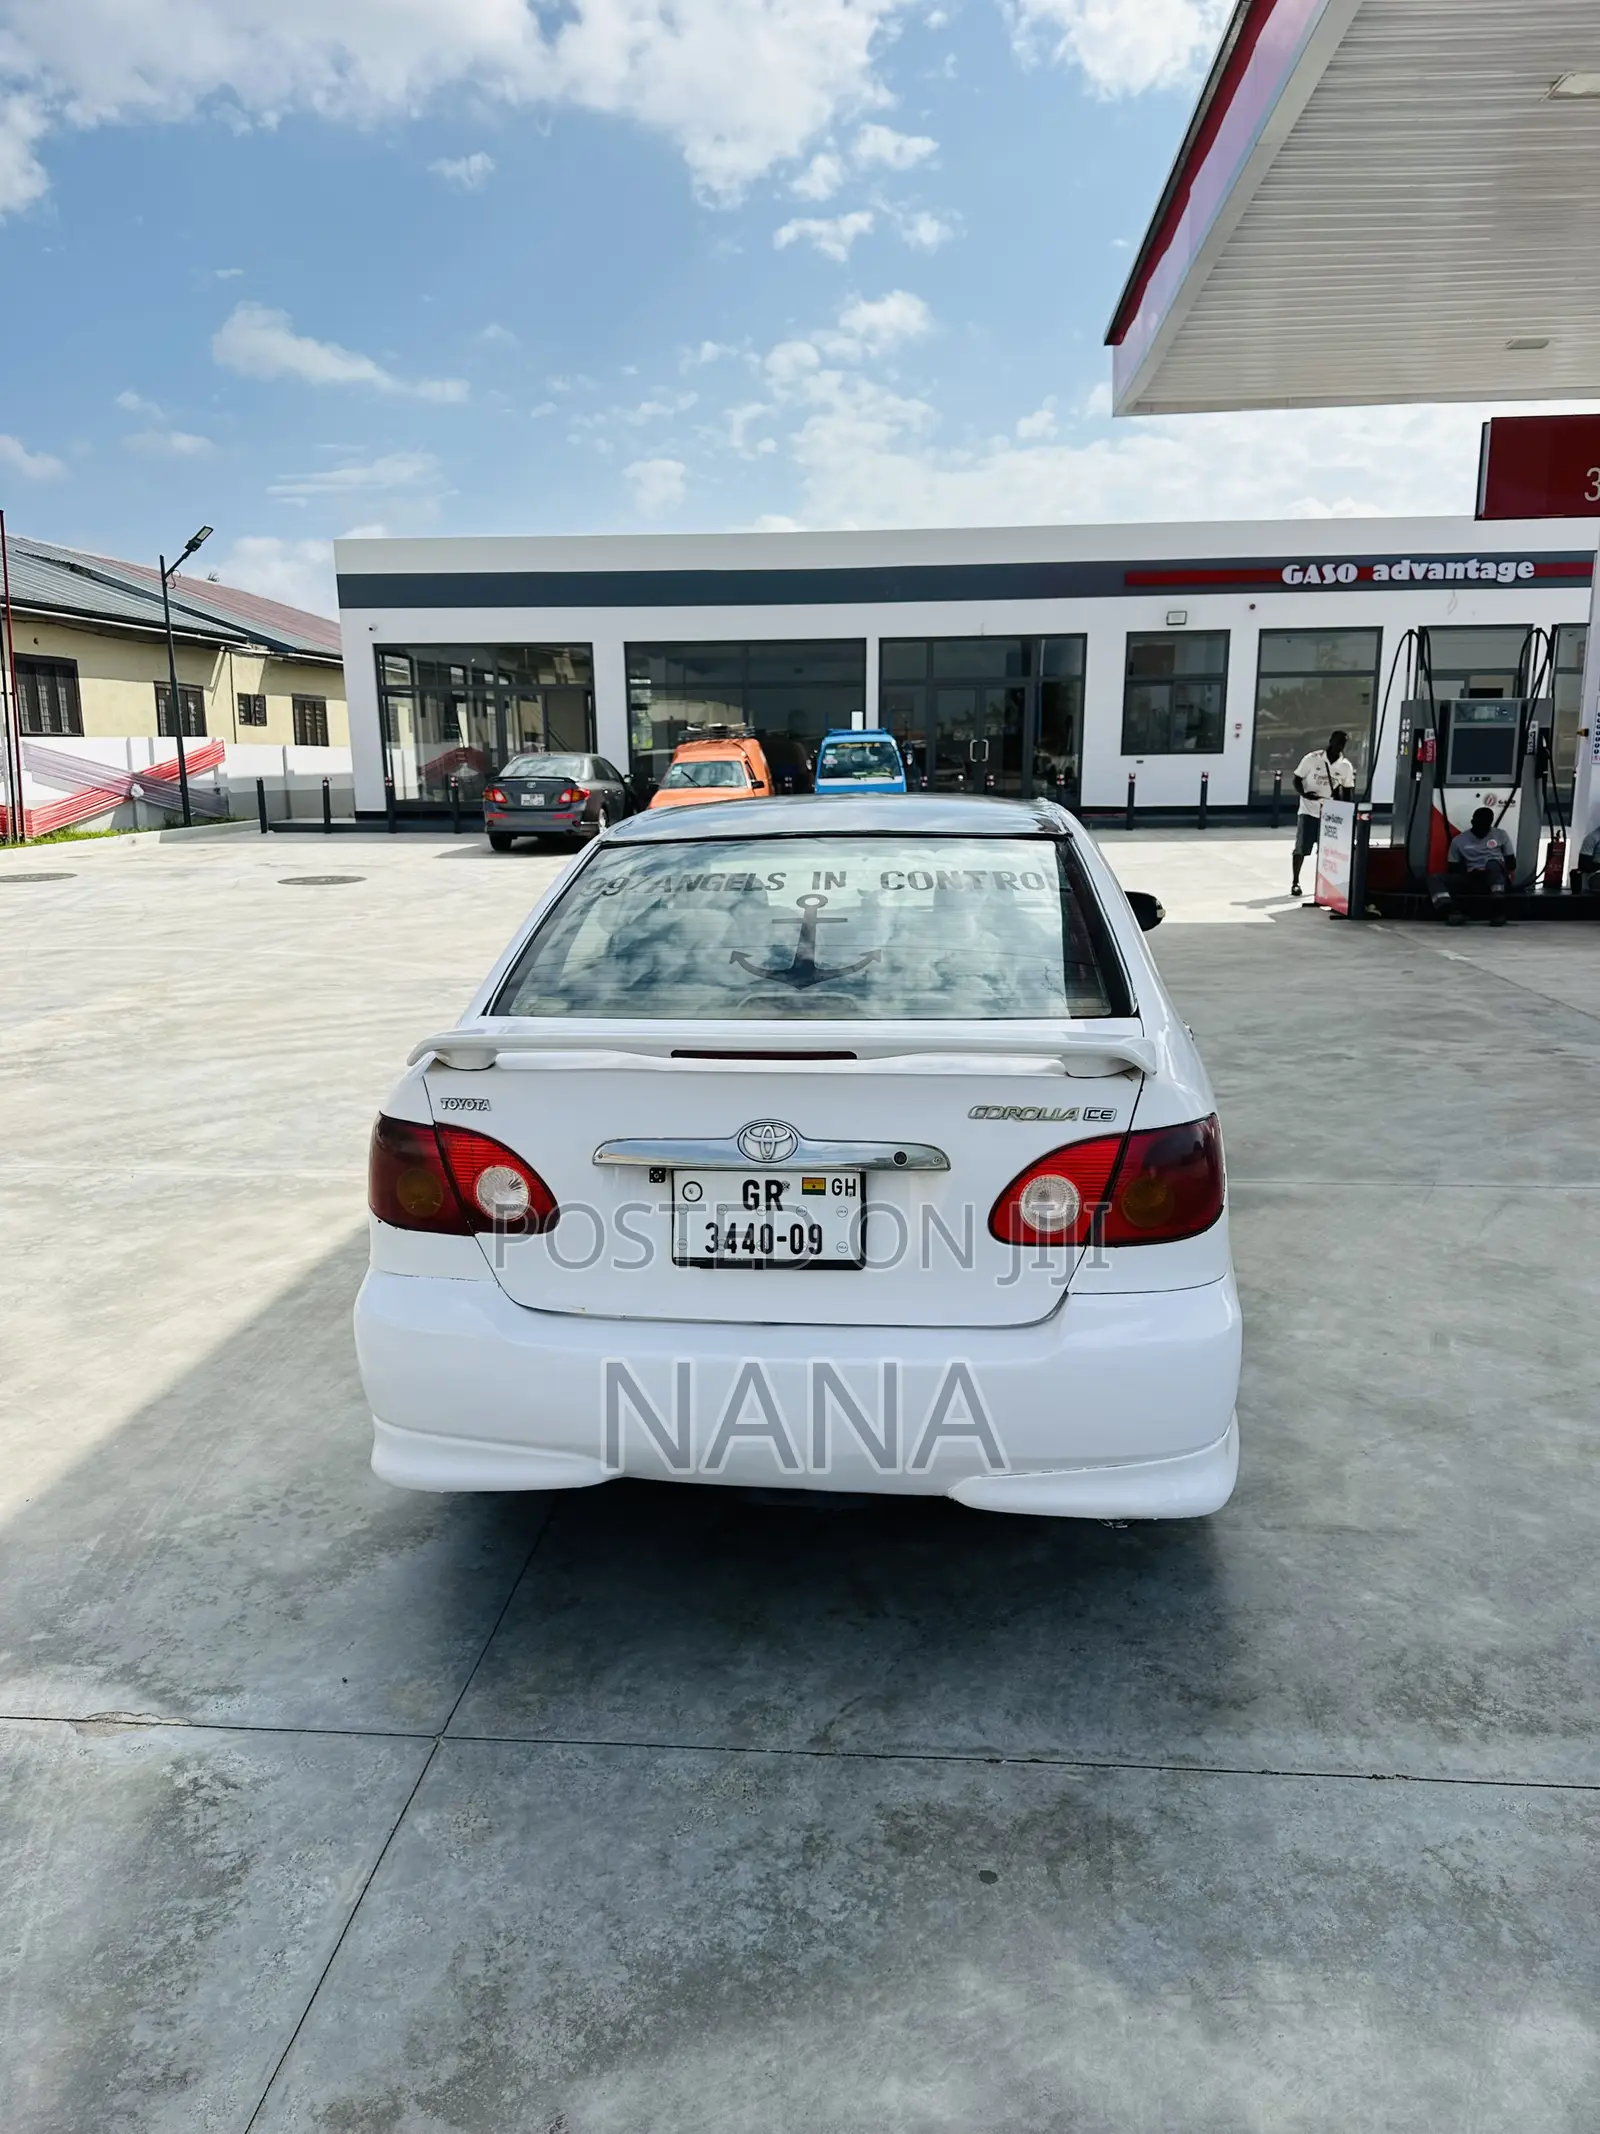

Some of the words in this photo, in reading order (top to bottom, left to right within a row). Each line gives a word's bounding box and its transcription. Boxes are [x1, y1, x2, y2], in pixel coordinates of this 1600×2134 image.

[1282, 563, 1358, 585] GASO
[1372, 558, 1536, 583] advantage
[644, 872, 787, 892] ANGELS
[811, 871, 847, 890] IN
[440, 1097, 491, 1111] TOYOTA
[968, 1105, 1080, 1121] COROLLA
[1085, 1107, 1115, 1121] CE
[742, 1179, 784, 1212] GR
[831, 1178, 857, 1198] GH
[704, 1222, 823, 1255] 3440-09
